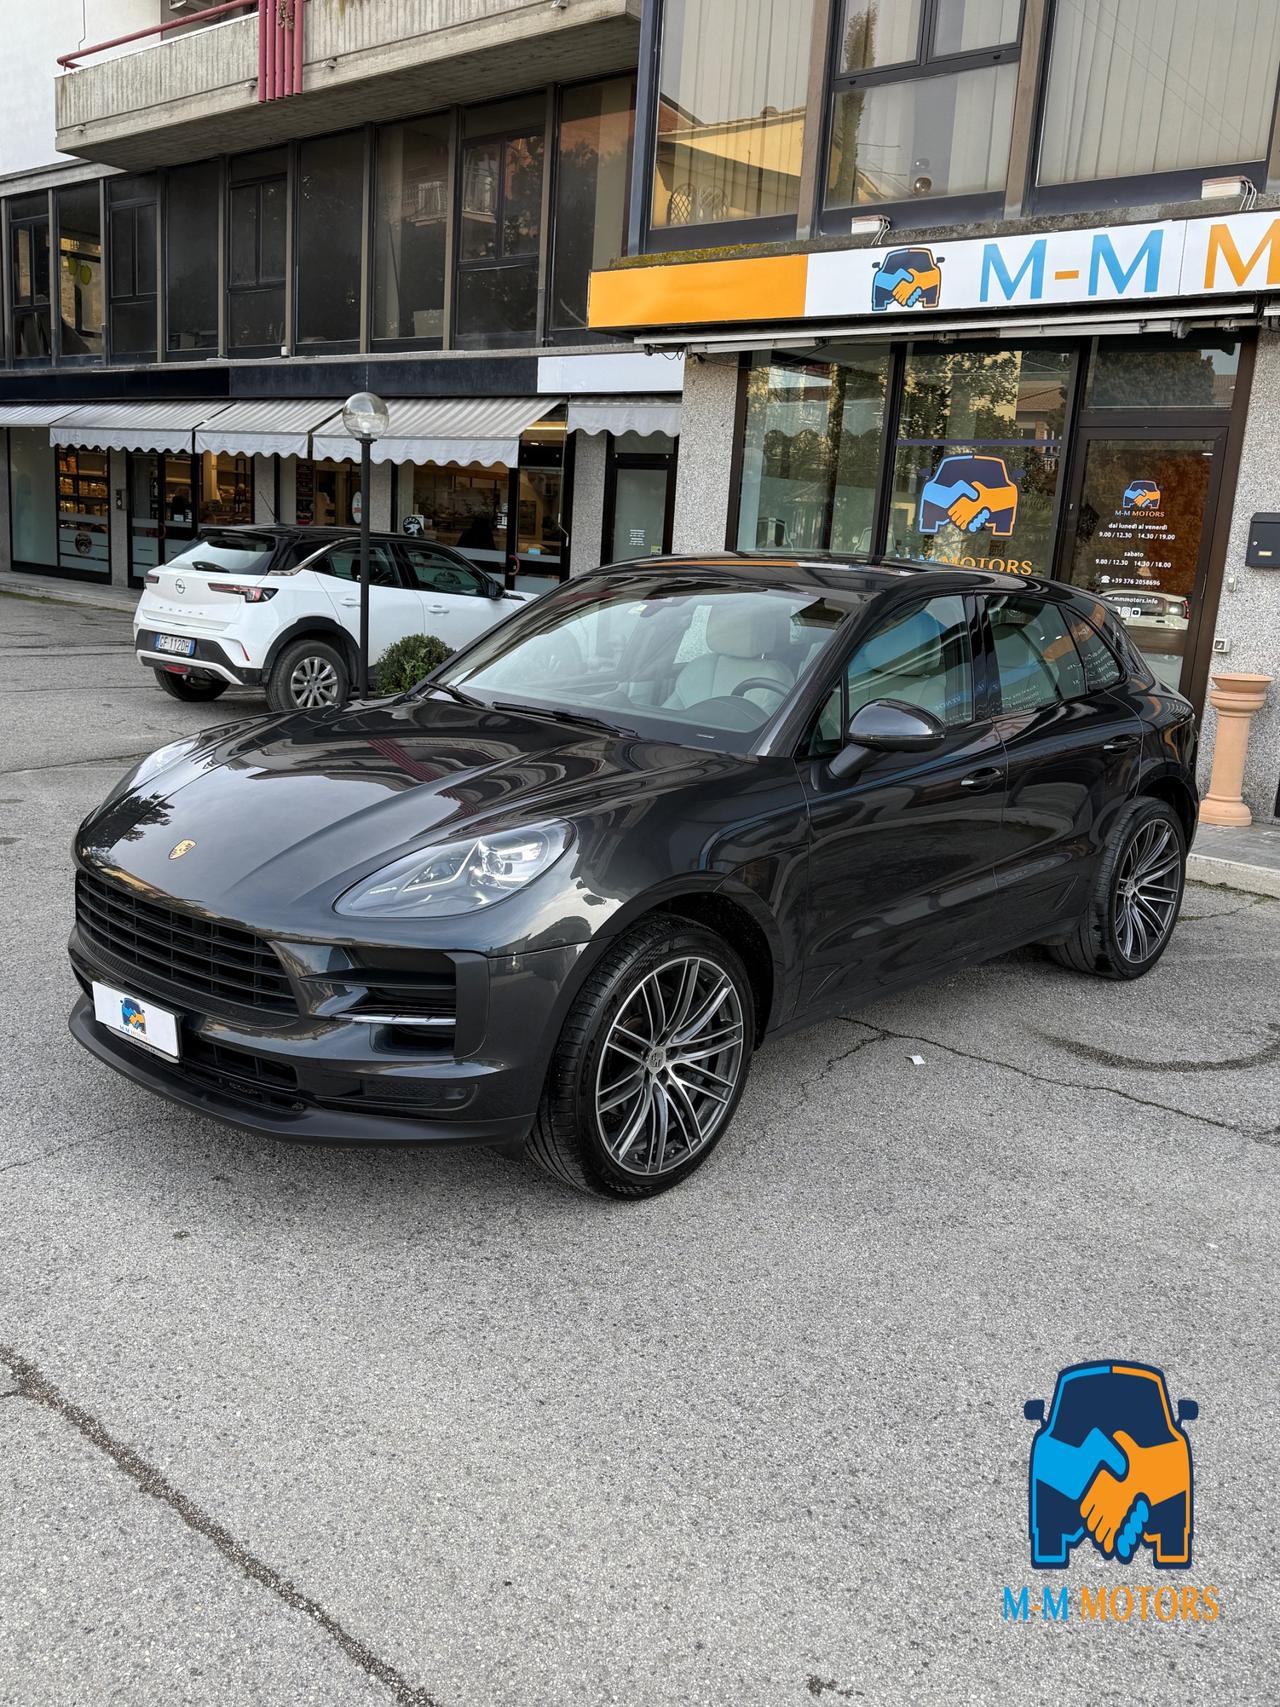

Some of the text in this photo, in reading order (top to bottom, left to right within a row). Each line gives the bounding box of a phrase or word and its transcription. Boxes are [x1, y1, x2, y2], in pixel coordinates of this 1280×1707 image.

[979, 229, 1164, 302] M-M
[1131, 510, 1165, 518] MOTORS
[1123, 550, 1144, 558] sabato
